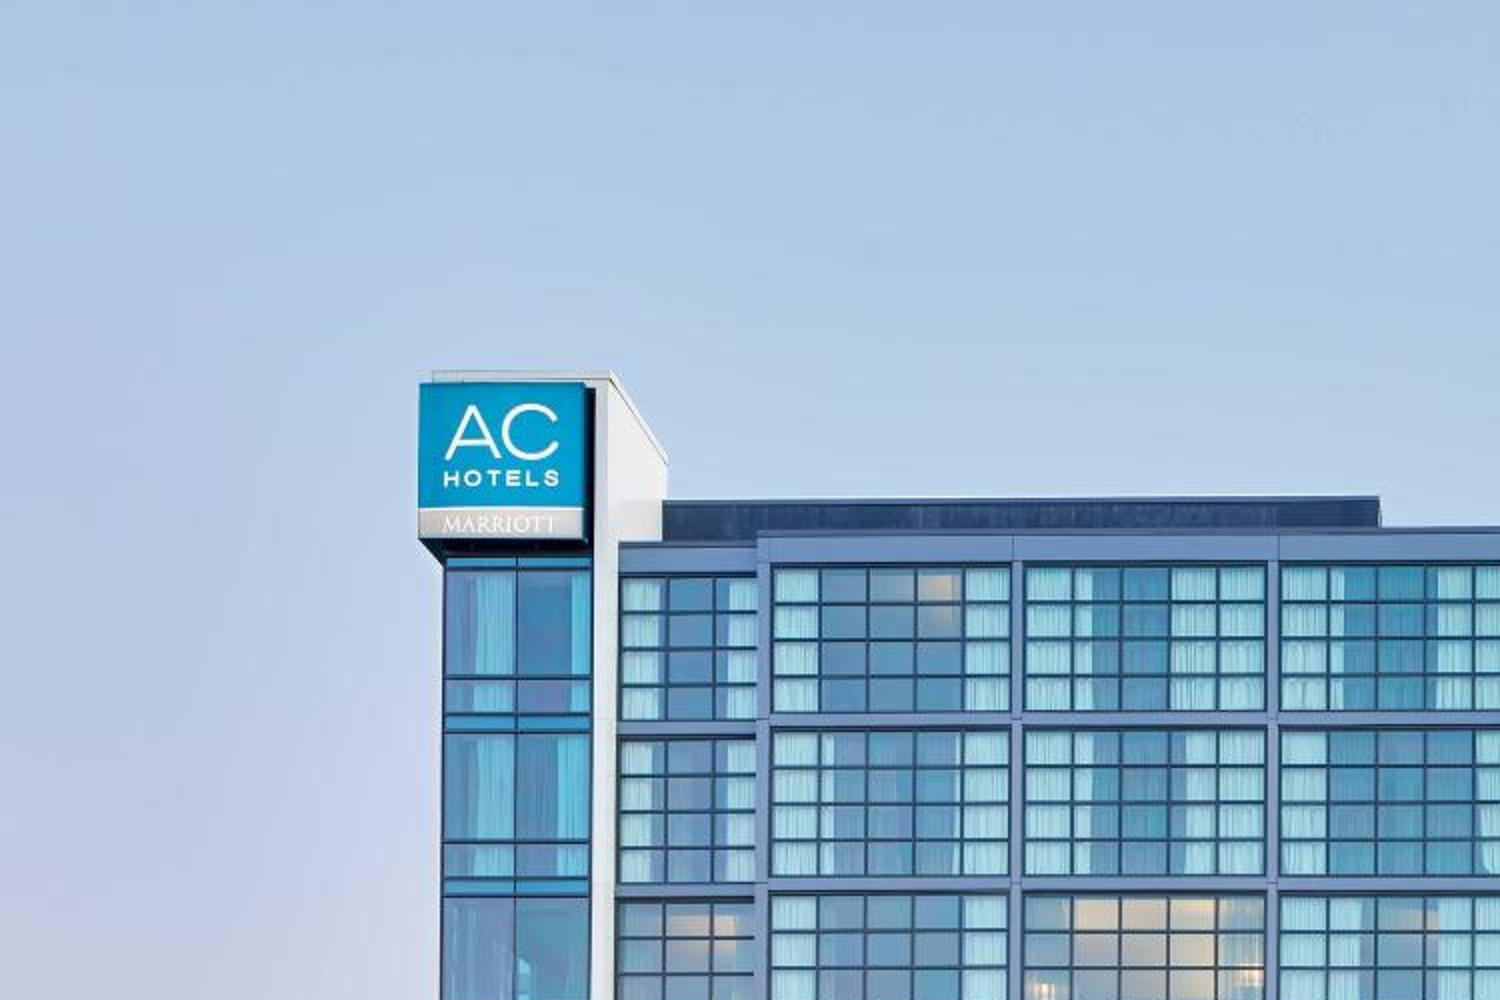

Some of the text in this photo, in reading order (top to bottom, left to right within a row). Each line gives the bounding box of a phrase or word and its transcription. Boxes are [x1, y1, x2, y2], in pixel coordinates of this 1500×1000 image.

[444, 403, 559, 461] AC
[443, 469, 559, 488] HOTELS
[442, 515, 556, 533] MARRIOTT
